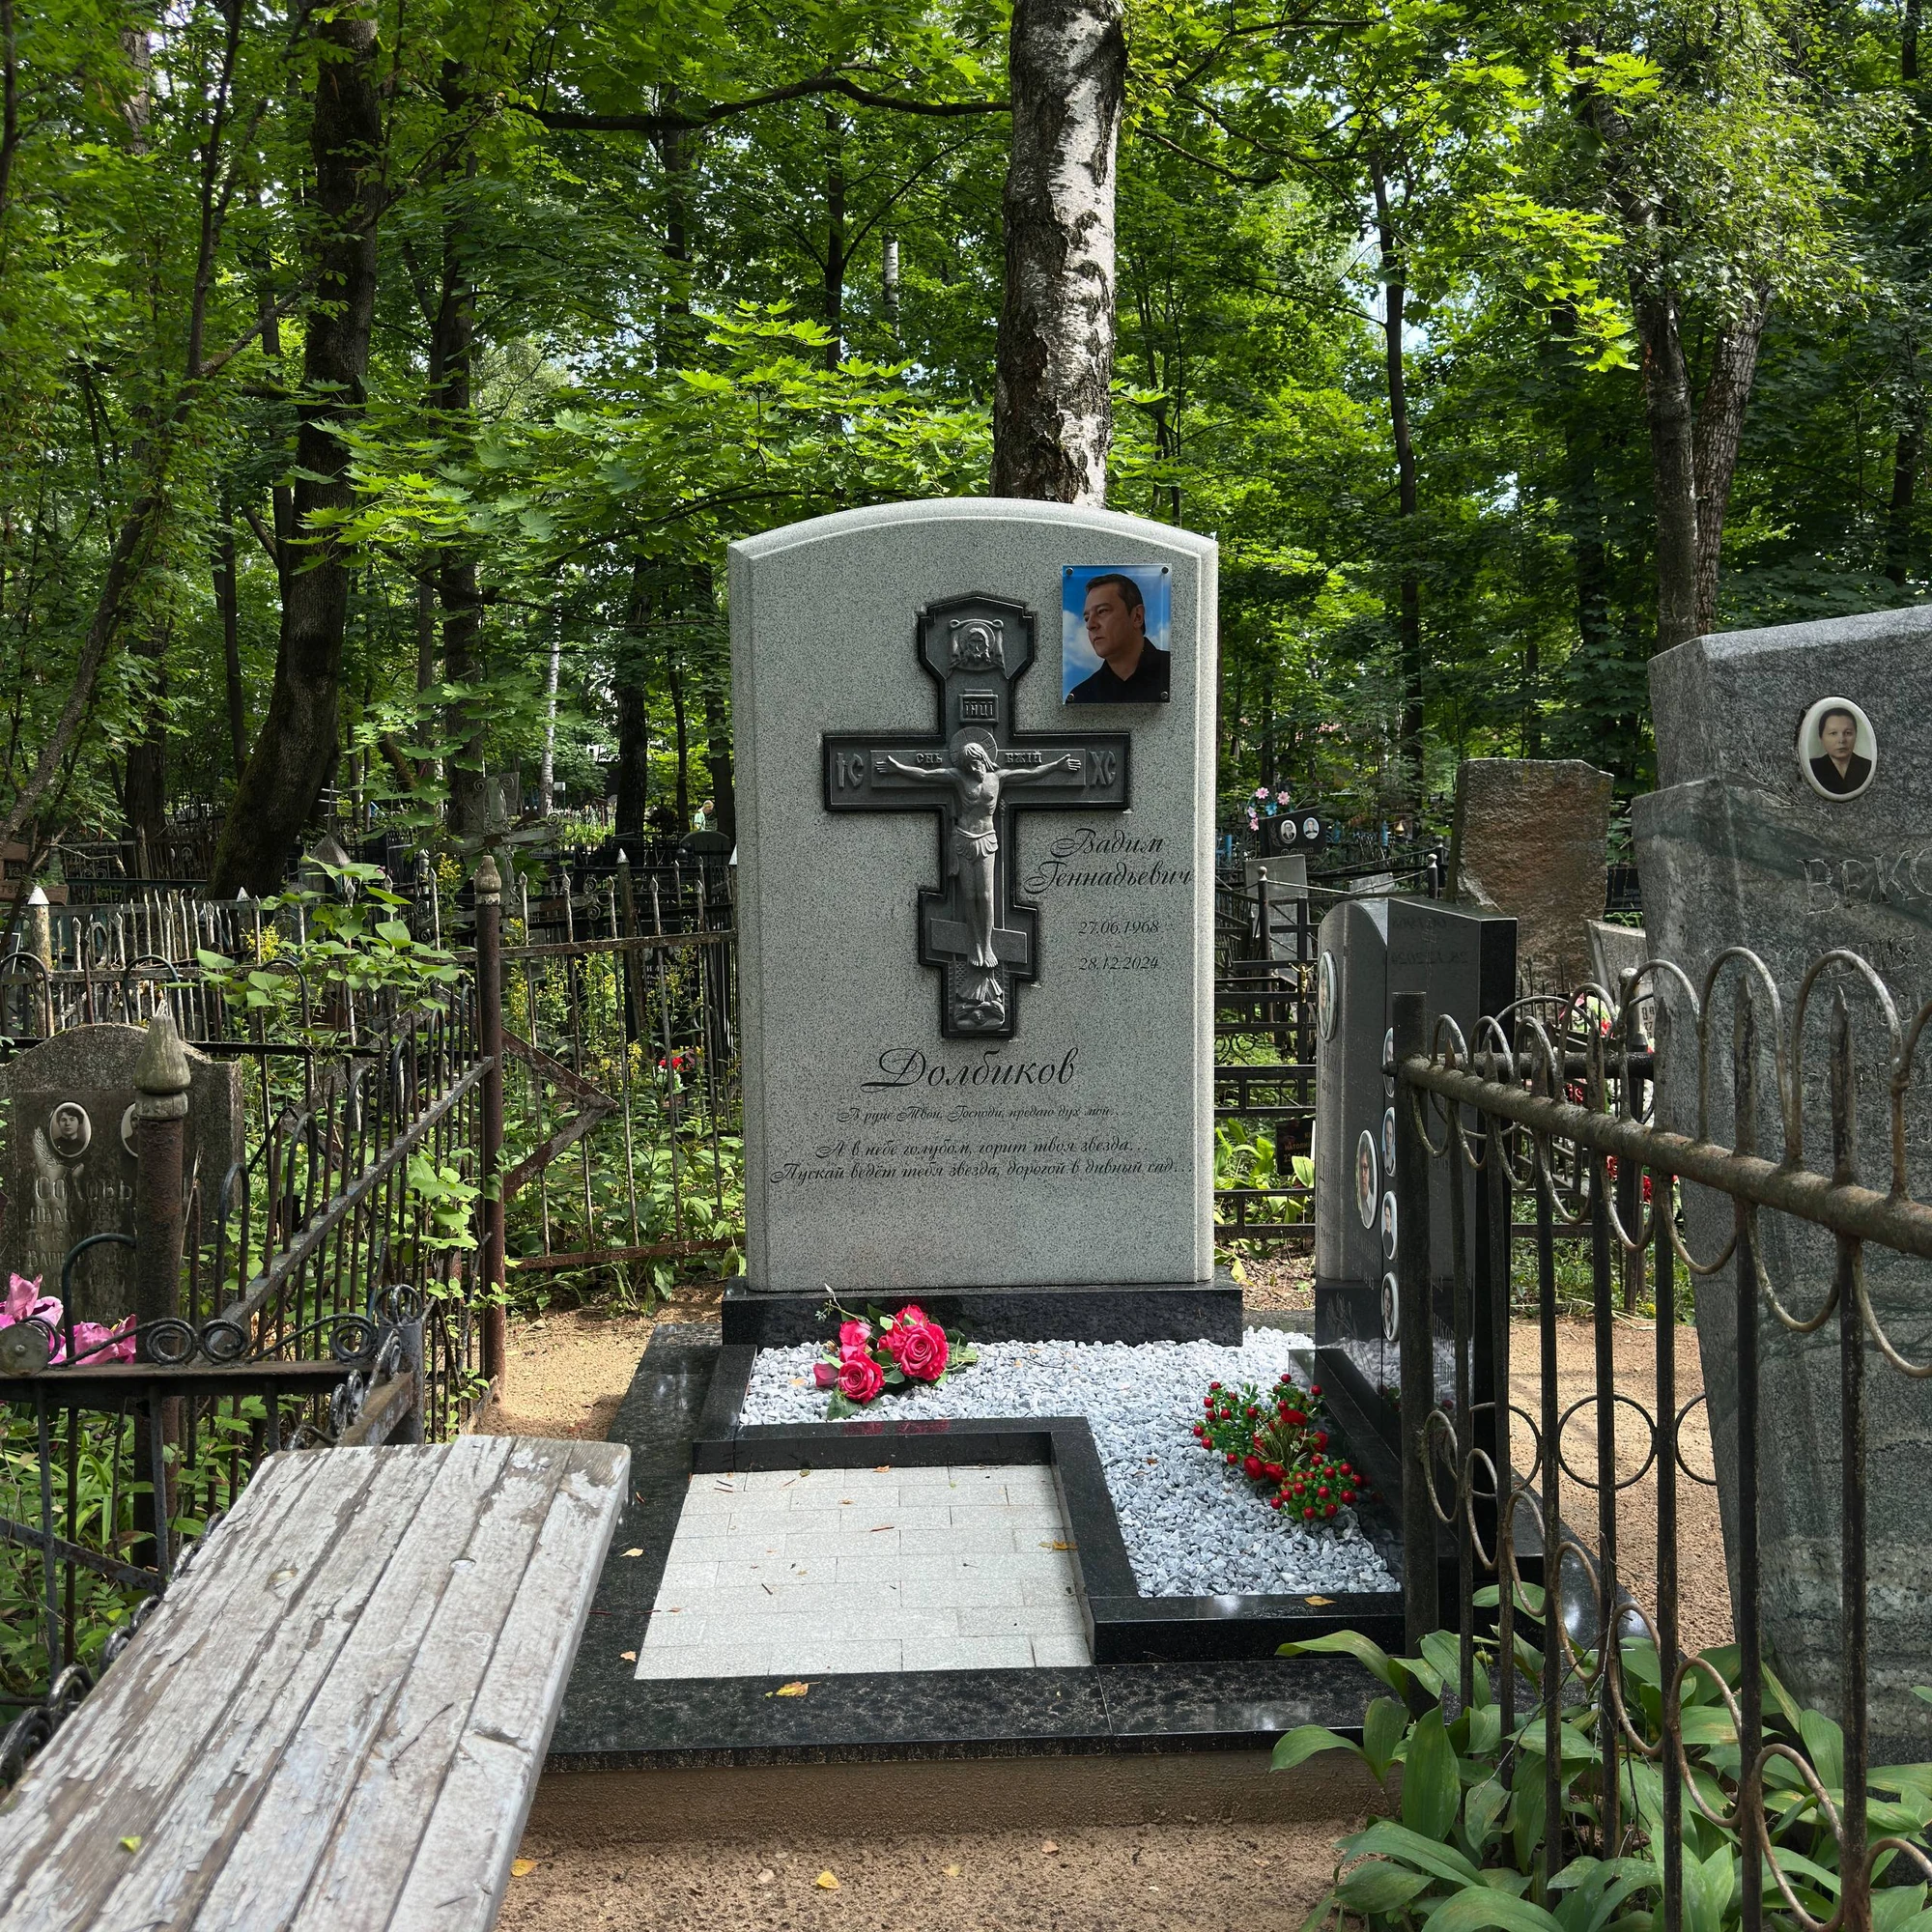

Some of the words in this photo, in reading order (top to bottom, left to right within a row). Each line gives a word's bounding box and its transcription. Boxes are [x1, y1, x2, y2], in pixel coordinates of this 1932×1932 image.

[1050, 828, 1165, 858] Вадим
[1023, 861, 1194, 895] Геннадьевич
[1078, 921, 1160, 935] 27.06.1968
[1078, 956, 1159, 970] 28.12.2024
[860, 1047, 1078, 1093] Долбиков
[1009, 1105, 1055, 1121] предаю
[1058, 1105, 1080, 1122] дух
[866, 1140, 898, 1156] небе
[979, 1143, 1027, 1159] горит
[1033, 1136, 1075, 1153] твоя
[770, 1163, 845, 1186] Пускай
[850, 1162, 896, 1179] ведёт
[902, 1161, 944, 1178] тебя
[1007, 1159, 1065, 1181] дорогой
[1071, 1158, 1080, 1175] в
[1085, 1159, 1142, 1175] дивный
